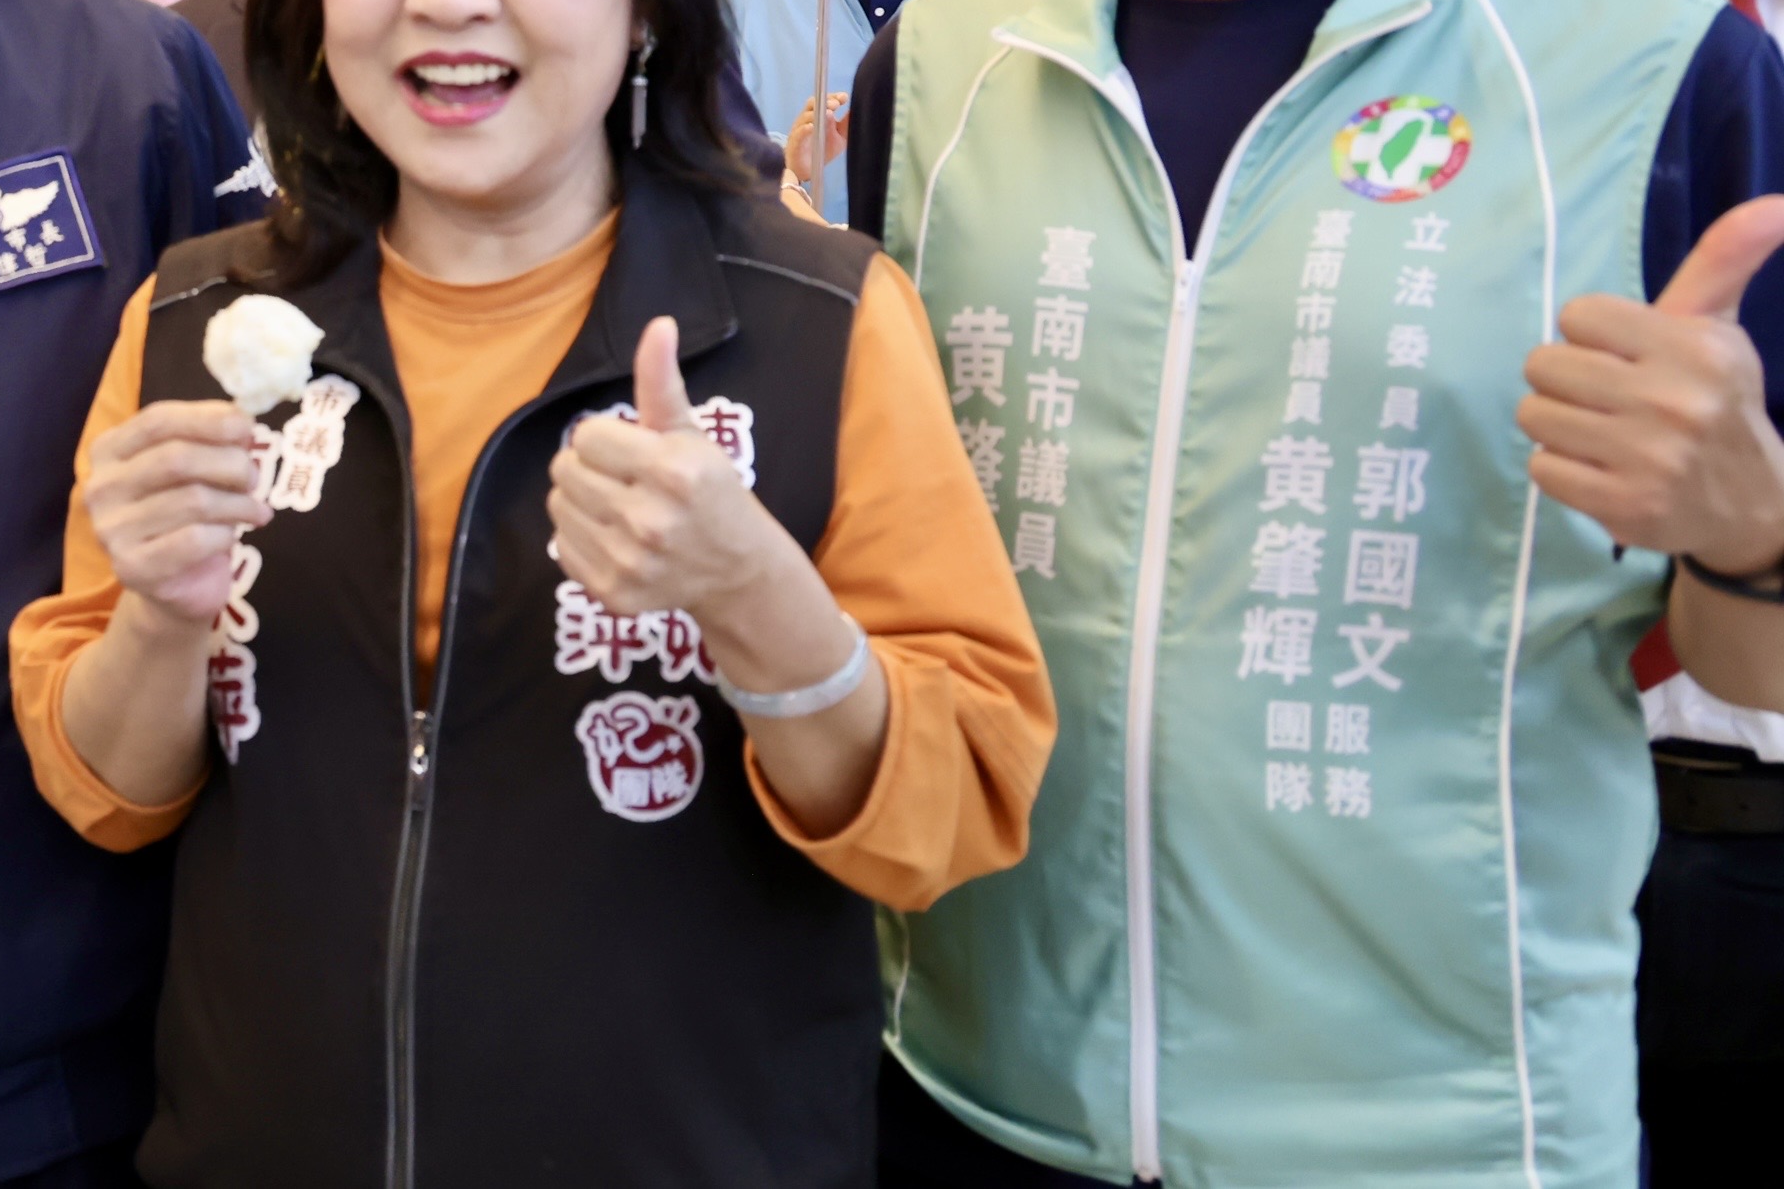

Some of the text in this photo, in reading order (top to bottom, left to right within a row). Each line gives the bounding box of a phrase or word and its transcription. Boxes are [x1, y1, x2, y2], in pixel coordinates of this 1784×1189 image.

[1012, 225, 1097, 581] 臺南市議員
